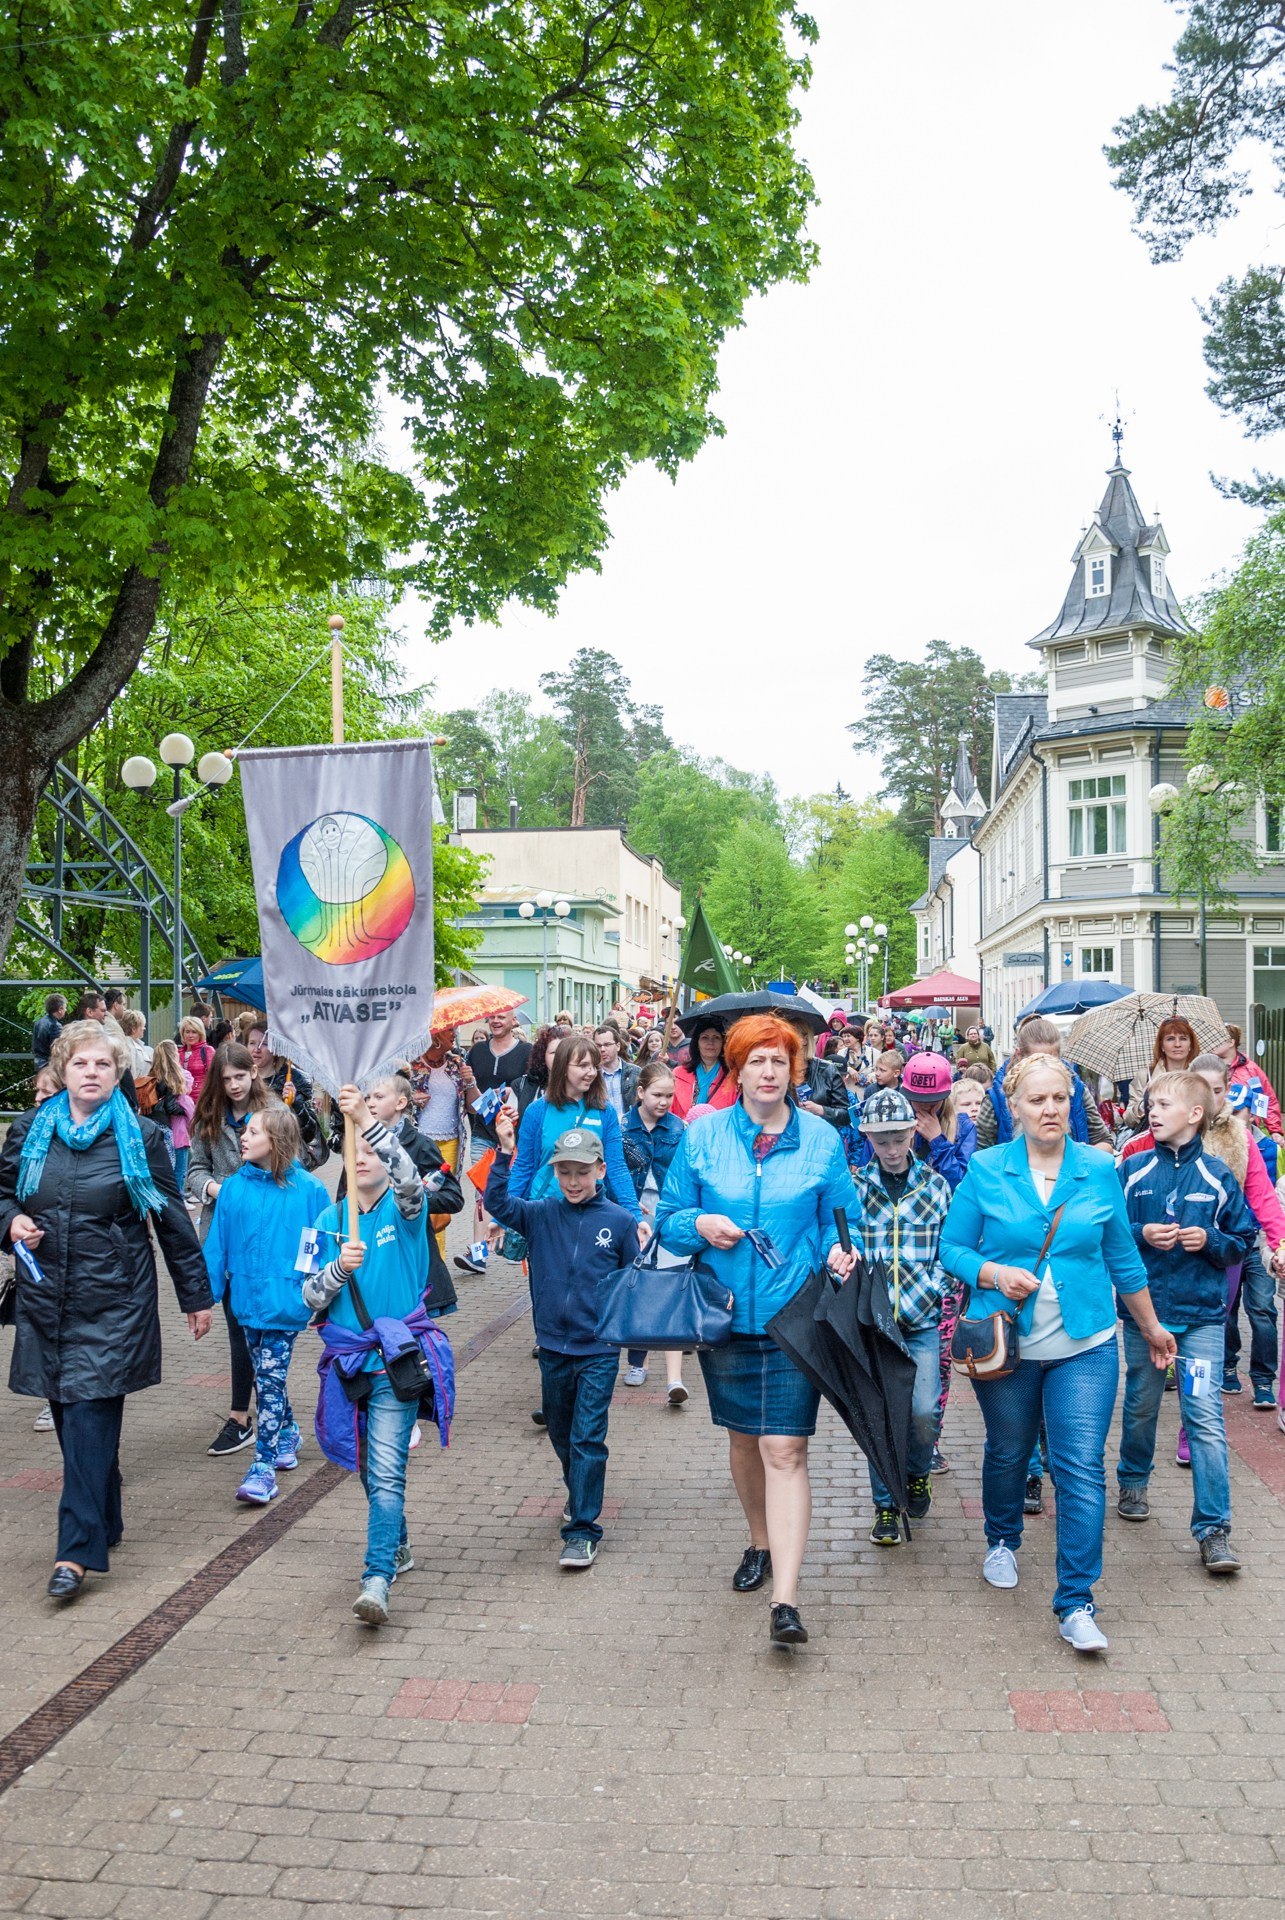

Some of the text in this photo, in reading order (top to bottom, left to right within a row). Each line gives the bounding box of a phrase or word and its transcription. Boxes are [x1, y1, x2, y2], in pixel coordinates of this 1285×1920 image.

[290, 983, 417, 998] Jūrmalas sākumskola
[911, 1074, 934, 1086] OBEY
